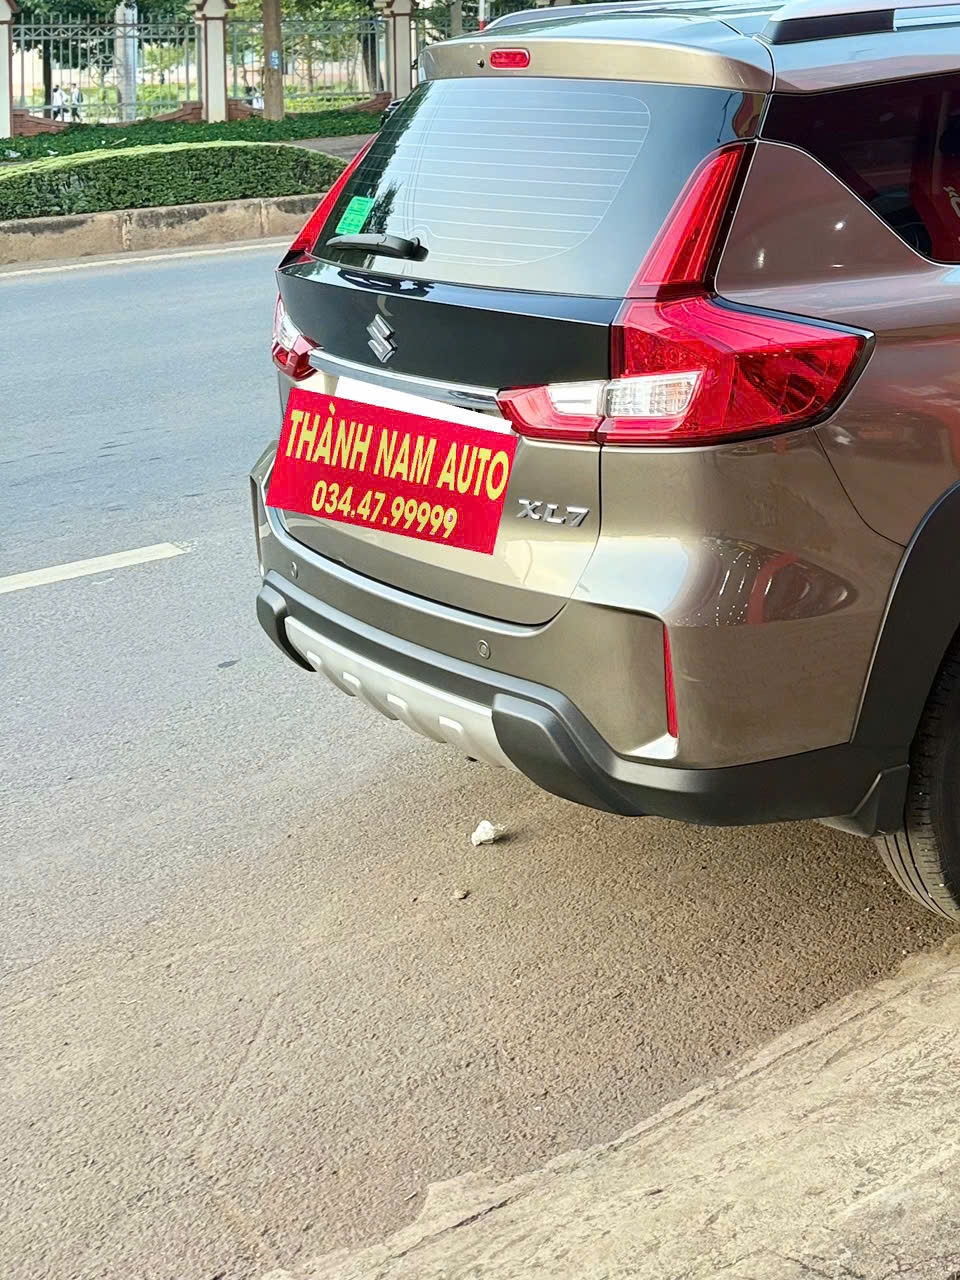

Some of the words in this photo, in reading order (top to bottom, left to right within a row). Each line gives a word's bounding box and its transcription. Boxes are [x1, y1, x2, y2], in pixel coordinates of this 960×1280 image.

[286, 401, 374, 472] THÀNH
[374, 428, 437, 486] NAM
[436, 442, 510, 501] AUTO
[311, 479, 458, 539] 034.47.99999
[516, 499, 590, 527] XL7
